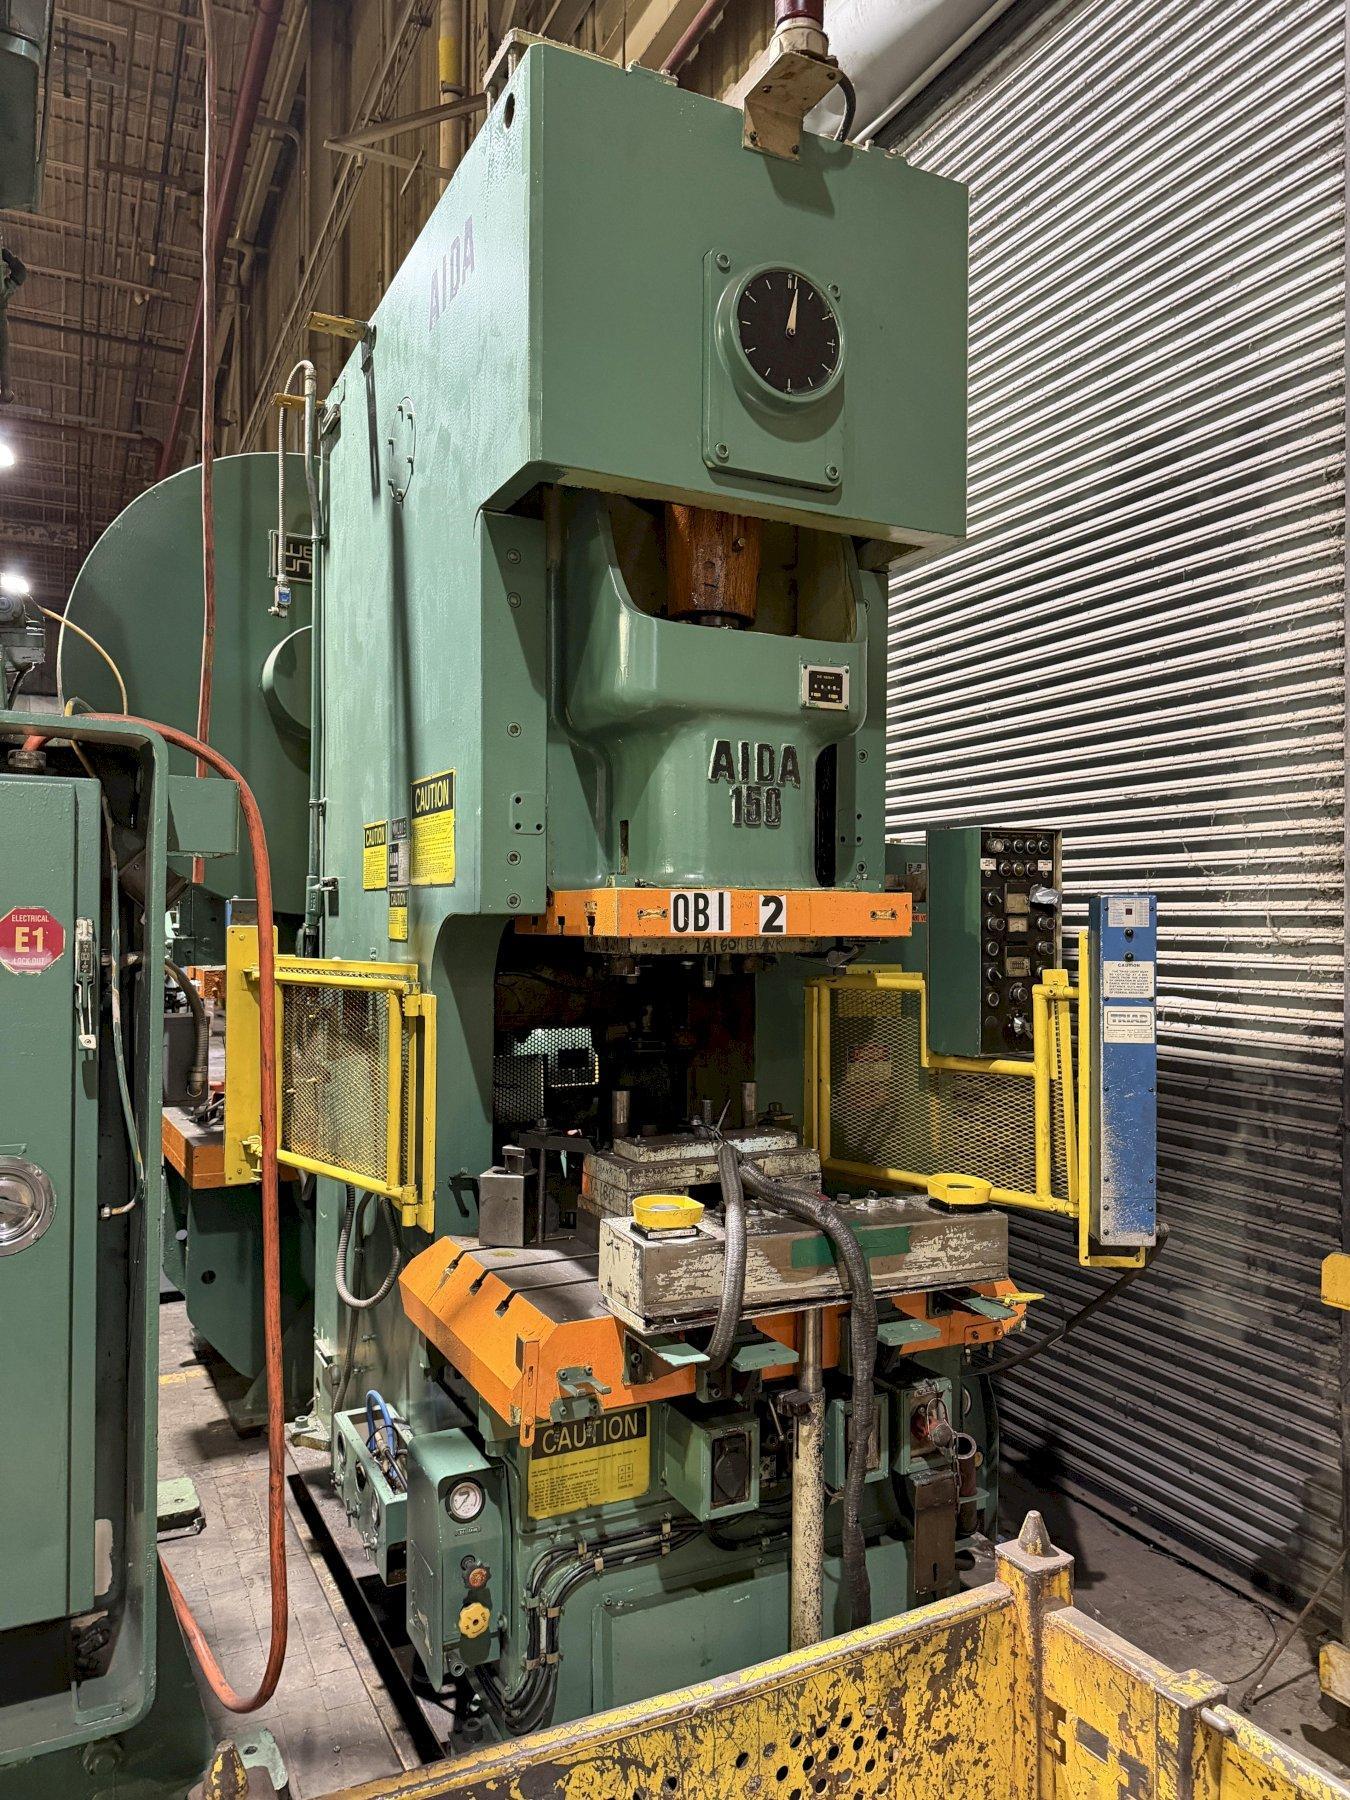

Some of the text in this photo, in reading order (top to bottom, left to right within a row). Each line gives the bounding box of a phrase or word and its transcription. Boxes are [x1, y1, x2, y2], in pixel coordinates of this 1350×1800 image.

[429, 214, 474, 333] AIDA
[708, 739, 801, 789] AIDA
[415, 779, 449, 814] CAUTION
[366, 826, 386, 846] CAUTION
[390, 893, 406, 906] CAUTION
[673, 892, 784, 933] OBI 2
[12, 914, 49, 922] ELECTRICAL
[15, 926, 44, 952] E1
[1110, 1013, 1148, 1024] TRIAD
[542, 1412, 638, 1454] CAUTION
